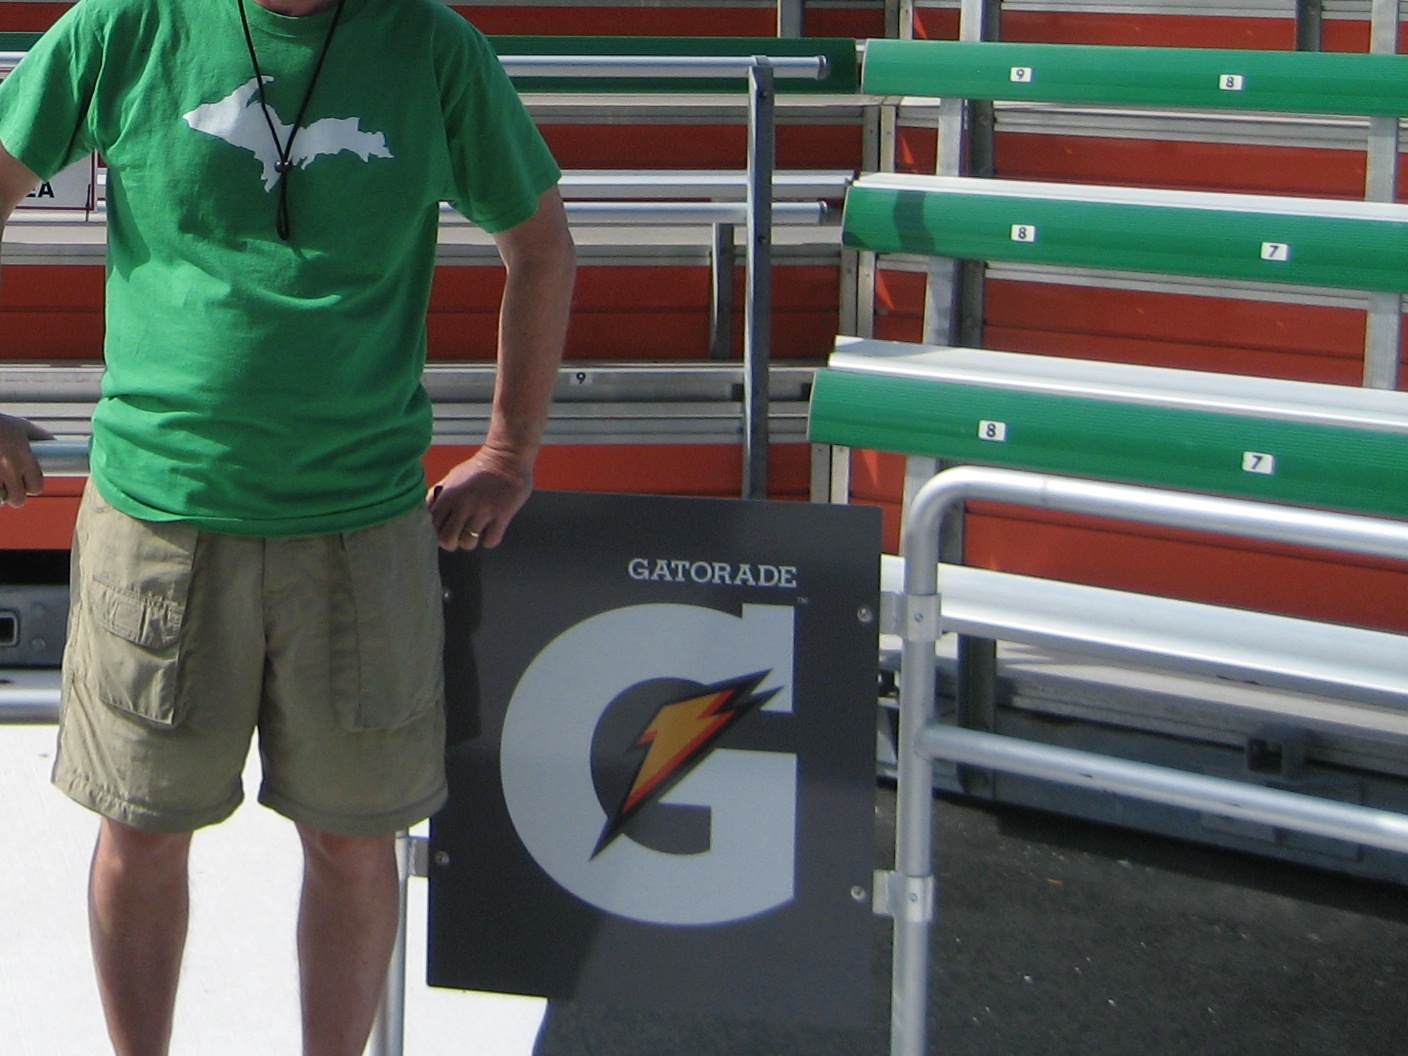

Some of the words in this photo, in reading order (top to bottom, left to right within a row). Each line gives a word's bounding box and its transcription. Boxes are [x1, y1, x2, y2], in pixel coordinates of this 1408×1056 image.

[576, 372, 586, 385] 9
[628, 558, 798, 589] GATORADE
[500, 603, 798, 926] G
